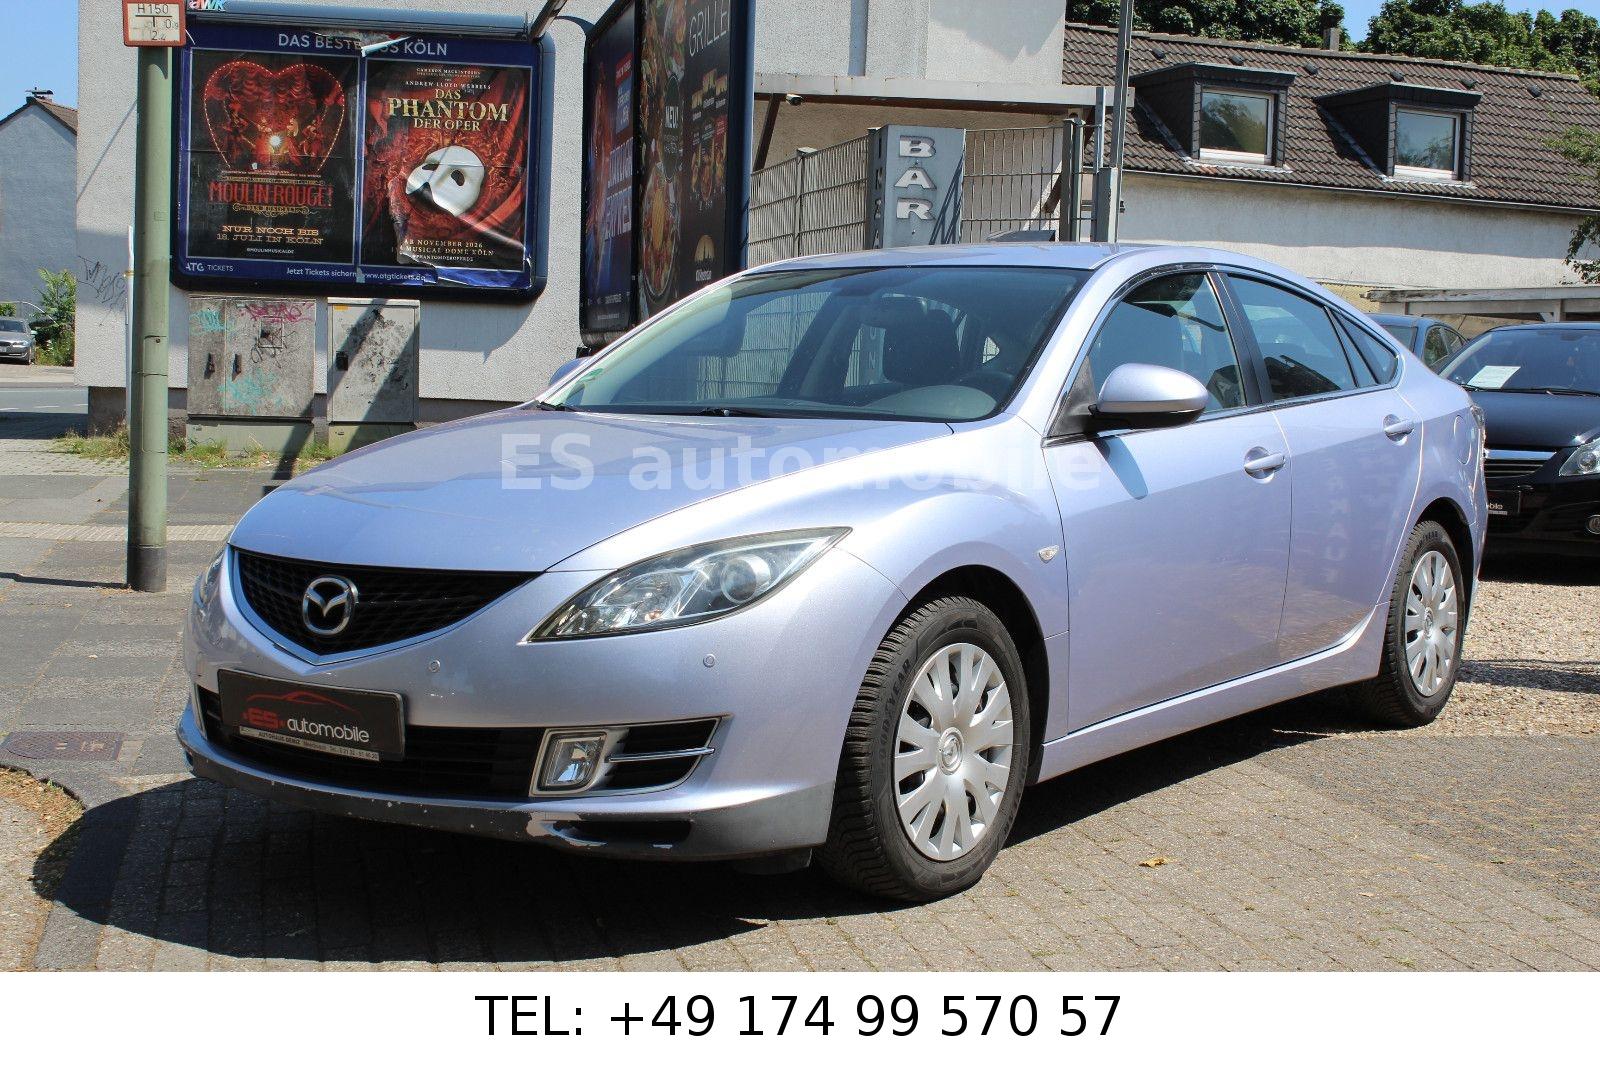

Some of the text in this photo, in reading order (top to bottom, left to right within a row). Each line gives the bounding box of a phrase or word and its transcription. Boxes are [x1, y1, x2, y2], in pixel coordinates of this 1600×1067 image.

[278, 34, 310, 47] DAS
[404, 38, 448, 56] KÖLN
[434, 88, 461, 100] DAS
[387, 97, 509, 122] PHANTOM
[413, 118, 481, 132] DER OPER
[894, 134, 937, 220] BAR
[208, 181, 334, 208] MOULIN ROUGE!
[222, 225, 319, 236] NUR NOCH BIS
[232, 234, 263, 242] JULI
[266, 235, 283, 243] IN
[286, 236, 323, 245] KÖLN
[417, 239, 462, 248] NOVEMBER
[405, 245, 440, 253] MUSICAL
[472, 248, 495, 256] KÖLN
[207, 264, 234, 272] TICKETS
[286, 267, 303, 275] Jetzt
[305, 268, 330, 276] Tickets
[286, 718, 370, 742] automobile
